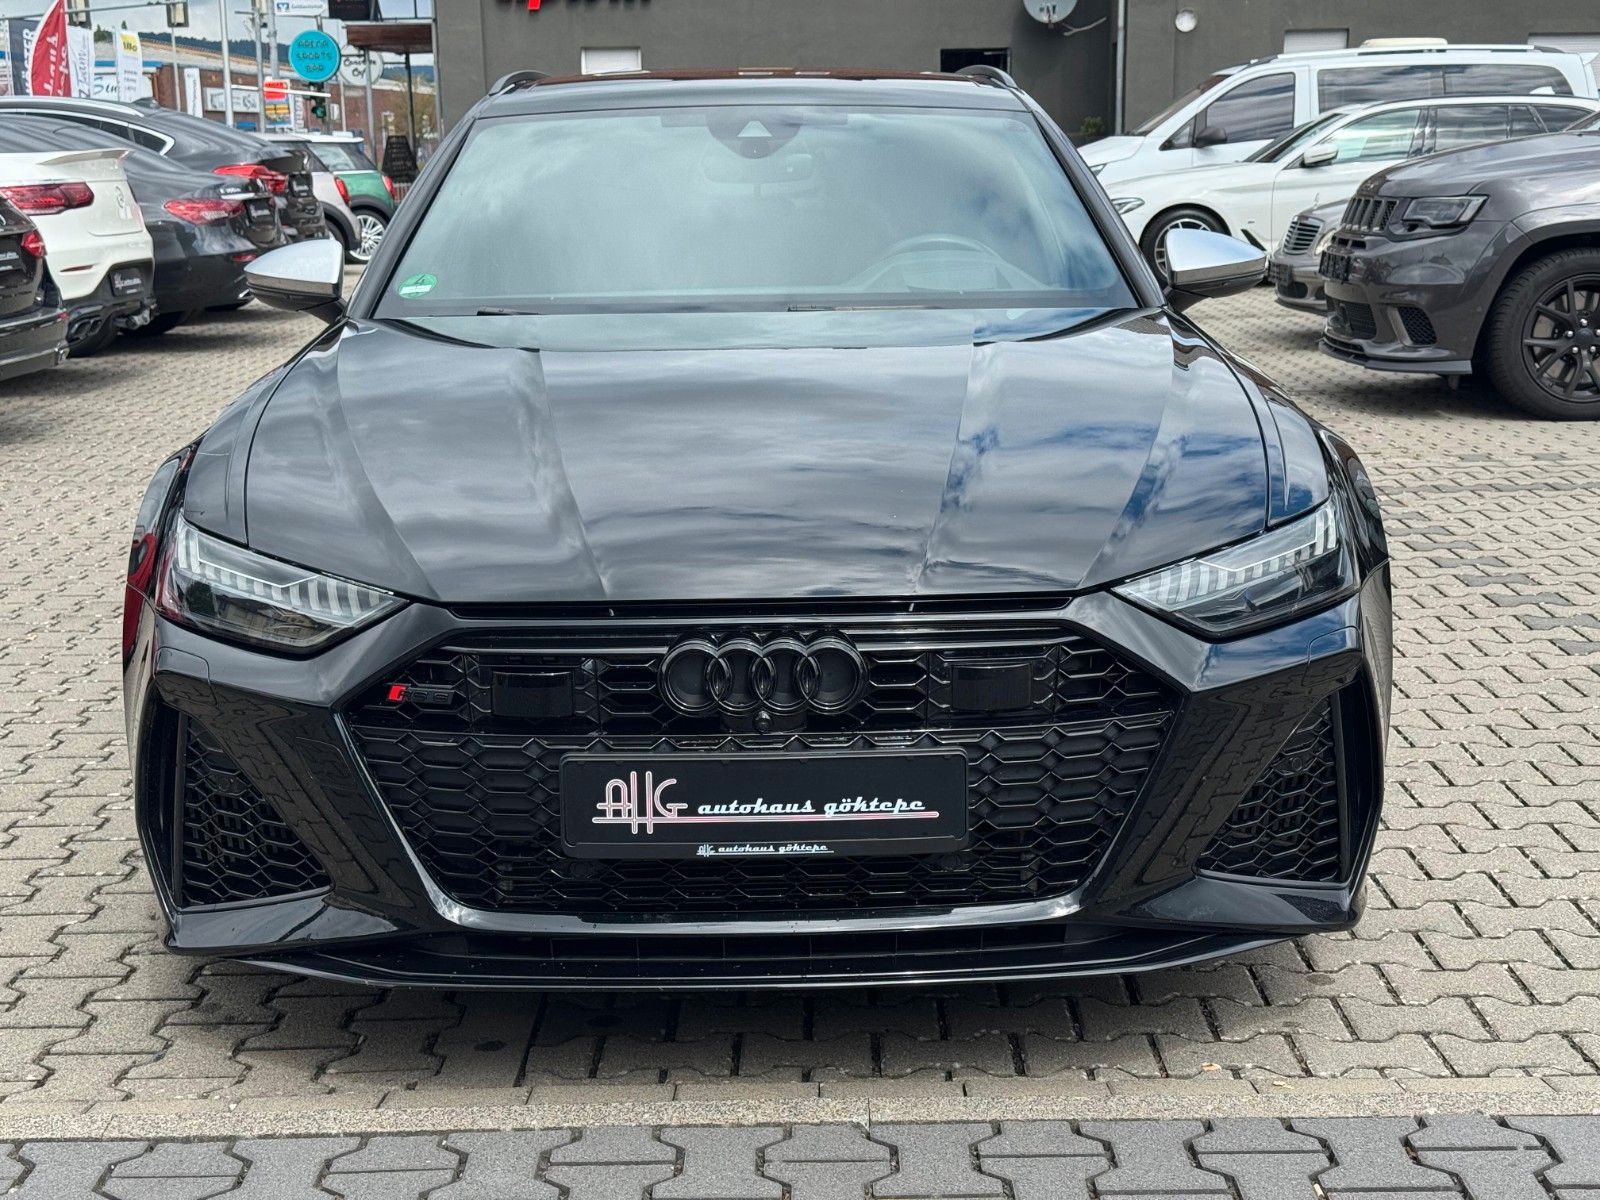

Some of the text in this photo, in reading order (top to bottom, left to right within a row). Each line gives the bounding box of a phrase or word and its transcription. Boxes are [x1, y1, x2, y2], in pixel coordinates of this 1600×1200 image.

[295, 51, 333, 61] SPORTS
[304, 63, 325, 73] BAR
[698, 798, 816, 815] autohaus
[823, 796, 926, 818] göktepe
[718, 844, 775, 854] autohaus
[778, 843, 829, 854] göktepe
